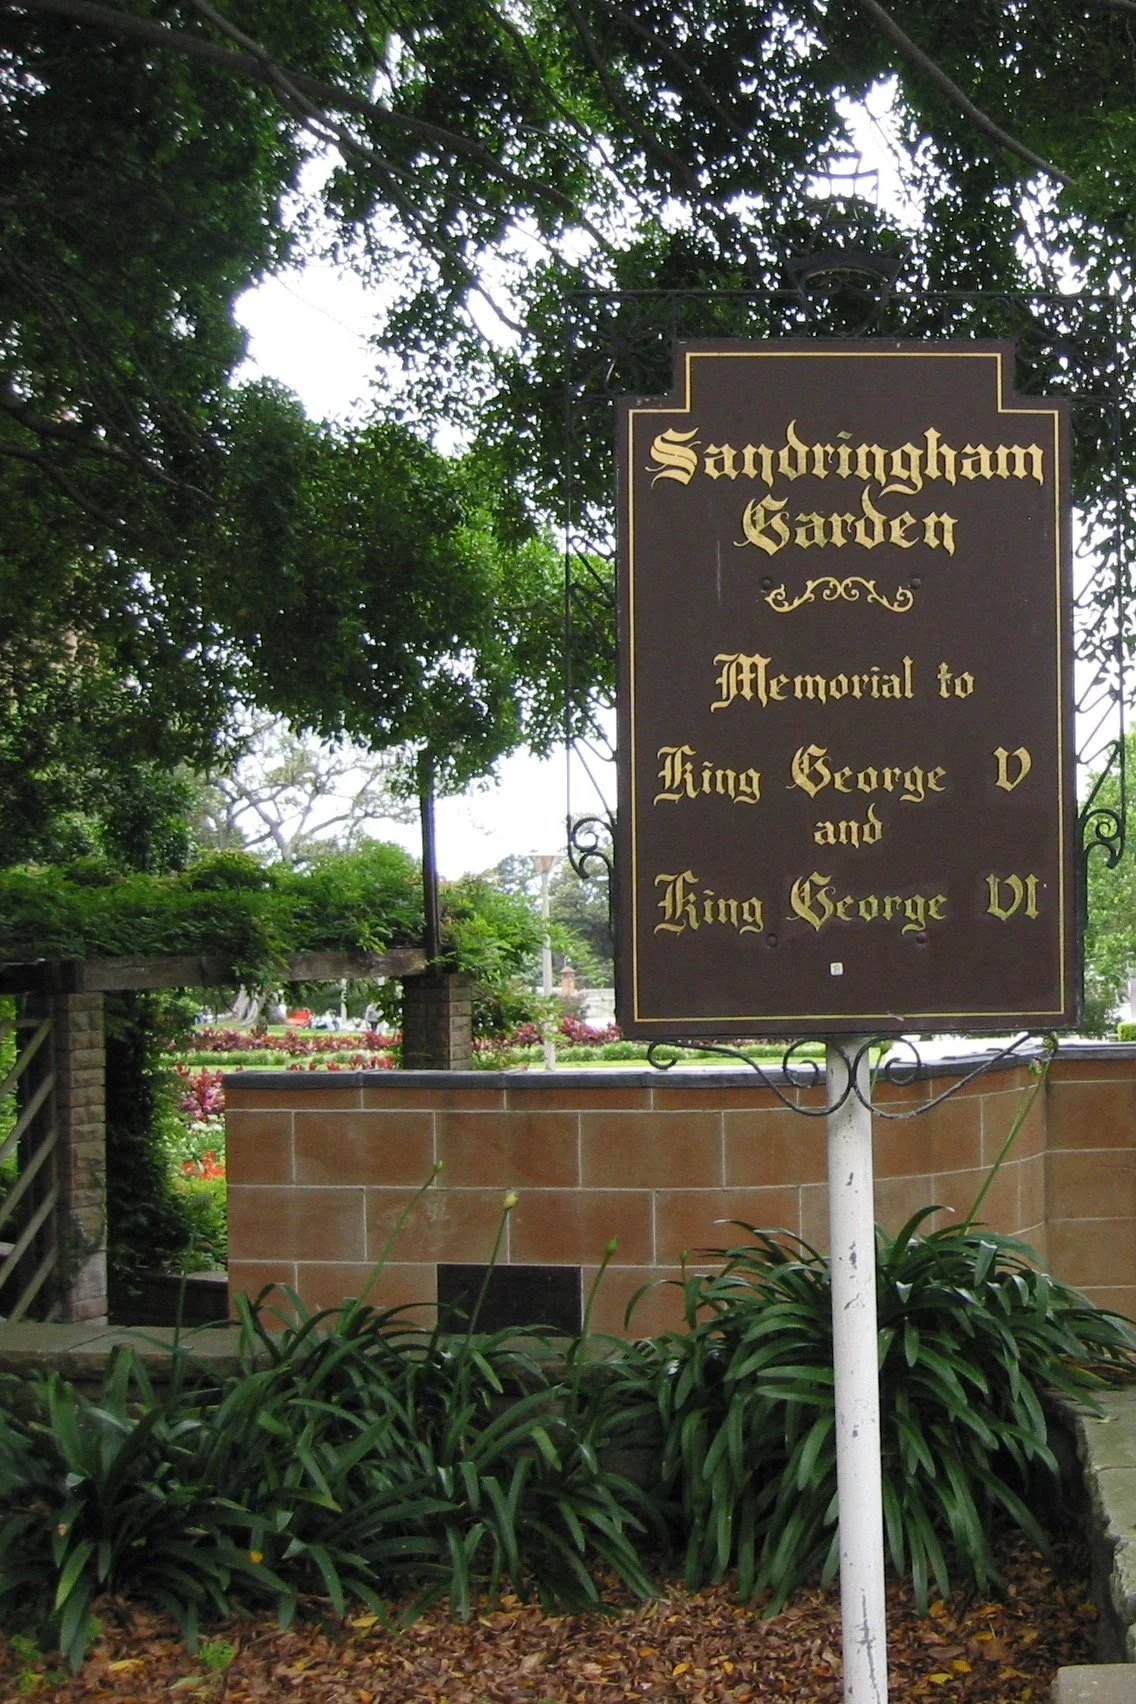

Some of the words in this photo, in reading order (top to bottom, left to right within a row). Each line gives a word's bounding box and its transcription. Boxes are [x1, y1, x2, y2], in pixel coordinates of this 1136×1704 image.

[645, 419, 1044, 497] Sandringham
[733, 485, 959, 557] Garden
[710, 653, 914, 712] Memorial
[937, 661, 975, 699] to
[653, 744, 761, 805] King
[787, 743, 947, 803] George
[993, 746, 1033, 792] V
[812, 803, 884, 849] and
[653, 869, 764, 935] King
[787, 871, 948, 935] George
[985, 873, 1040, 921] VI
